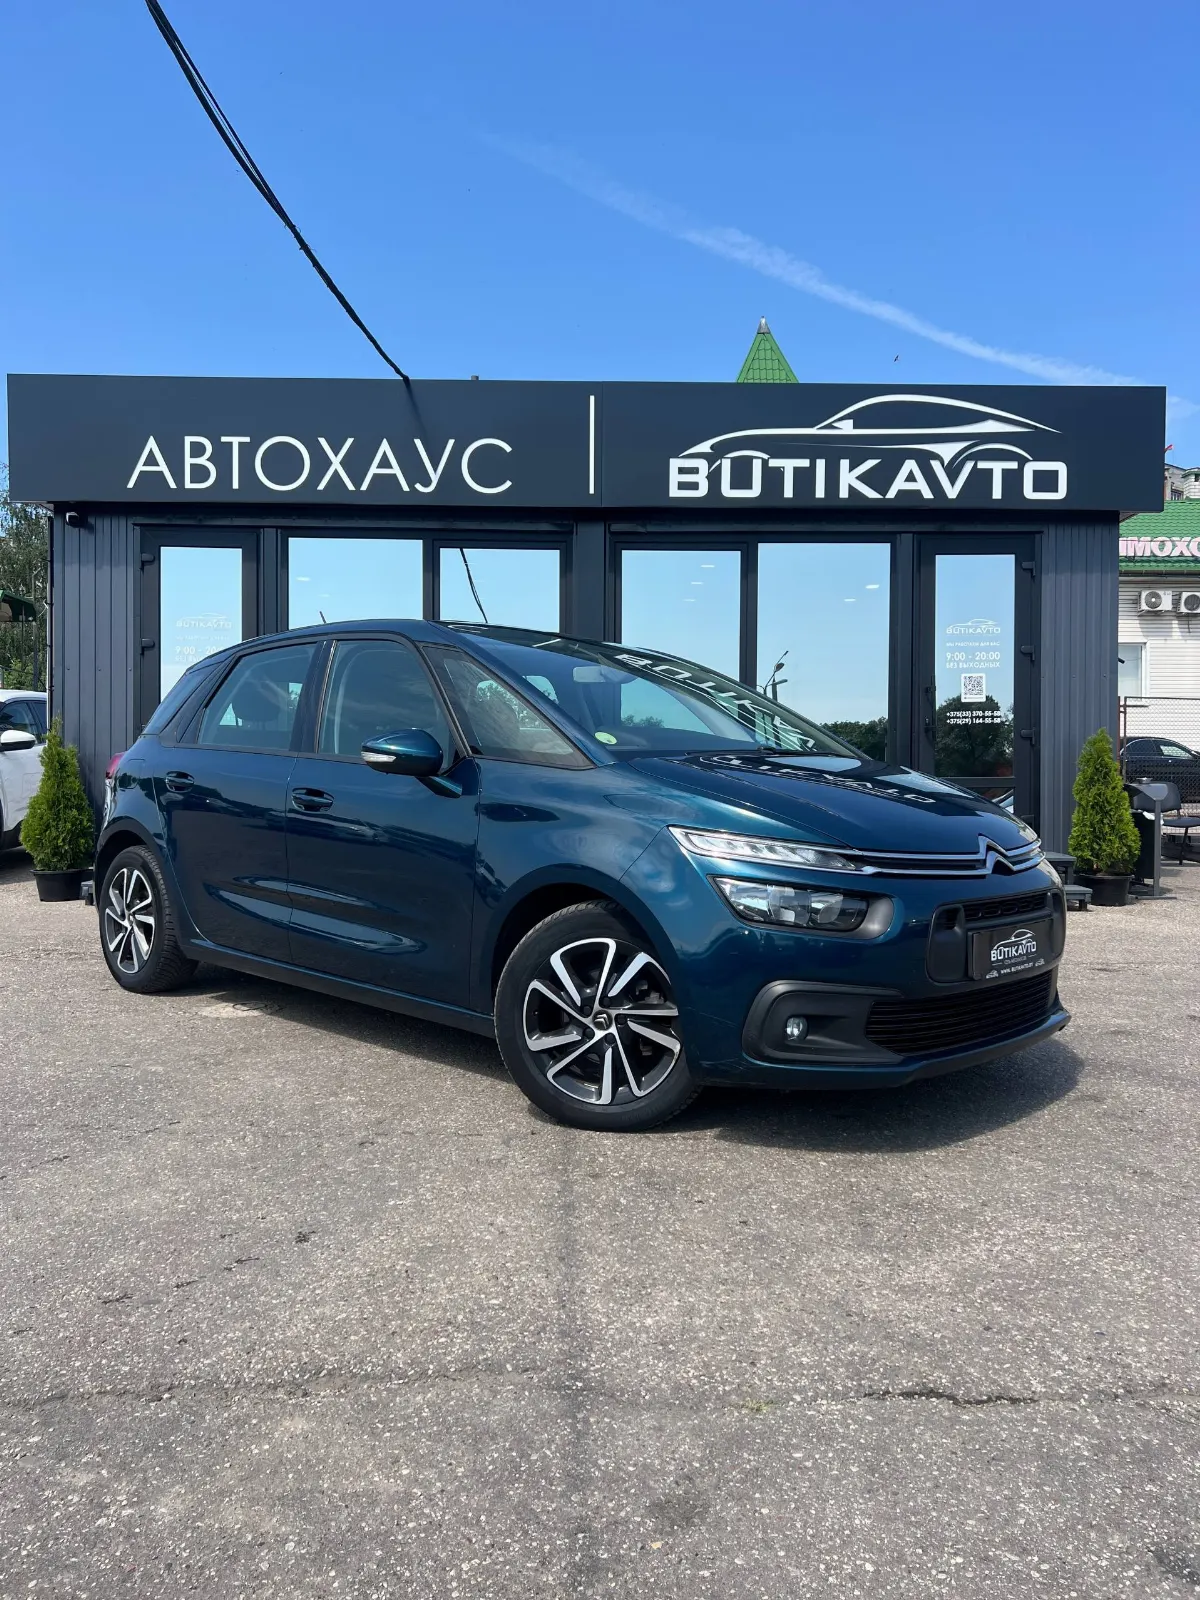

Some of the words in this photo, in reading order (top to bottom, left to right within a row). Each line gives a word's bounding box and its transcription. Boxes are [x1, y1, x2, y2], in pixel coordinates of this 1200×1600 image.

[126, 435, 513, 494] АВТОХАУС
[668, 457, 1068, 501] BUTIKAVTO
[946, 652, 966, 661] 9:00
[975, 651, 1001, 660] 20:00
[991, 942, 1036, 961] BUTIKAVTO
